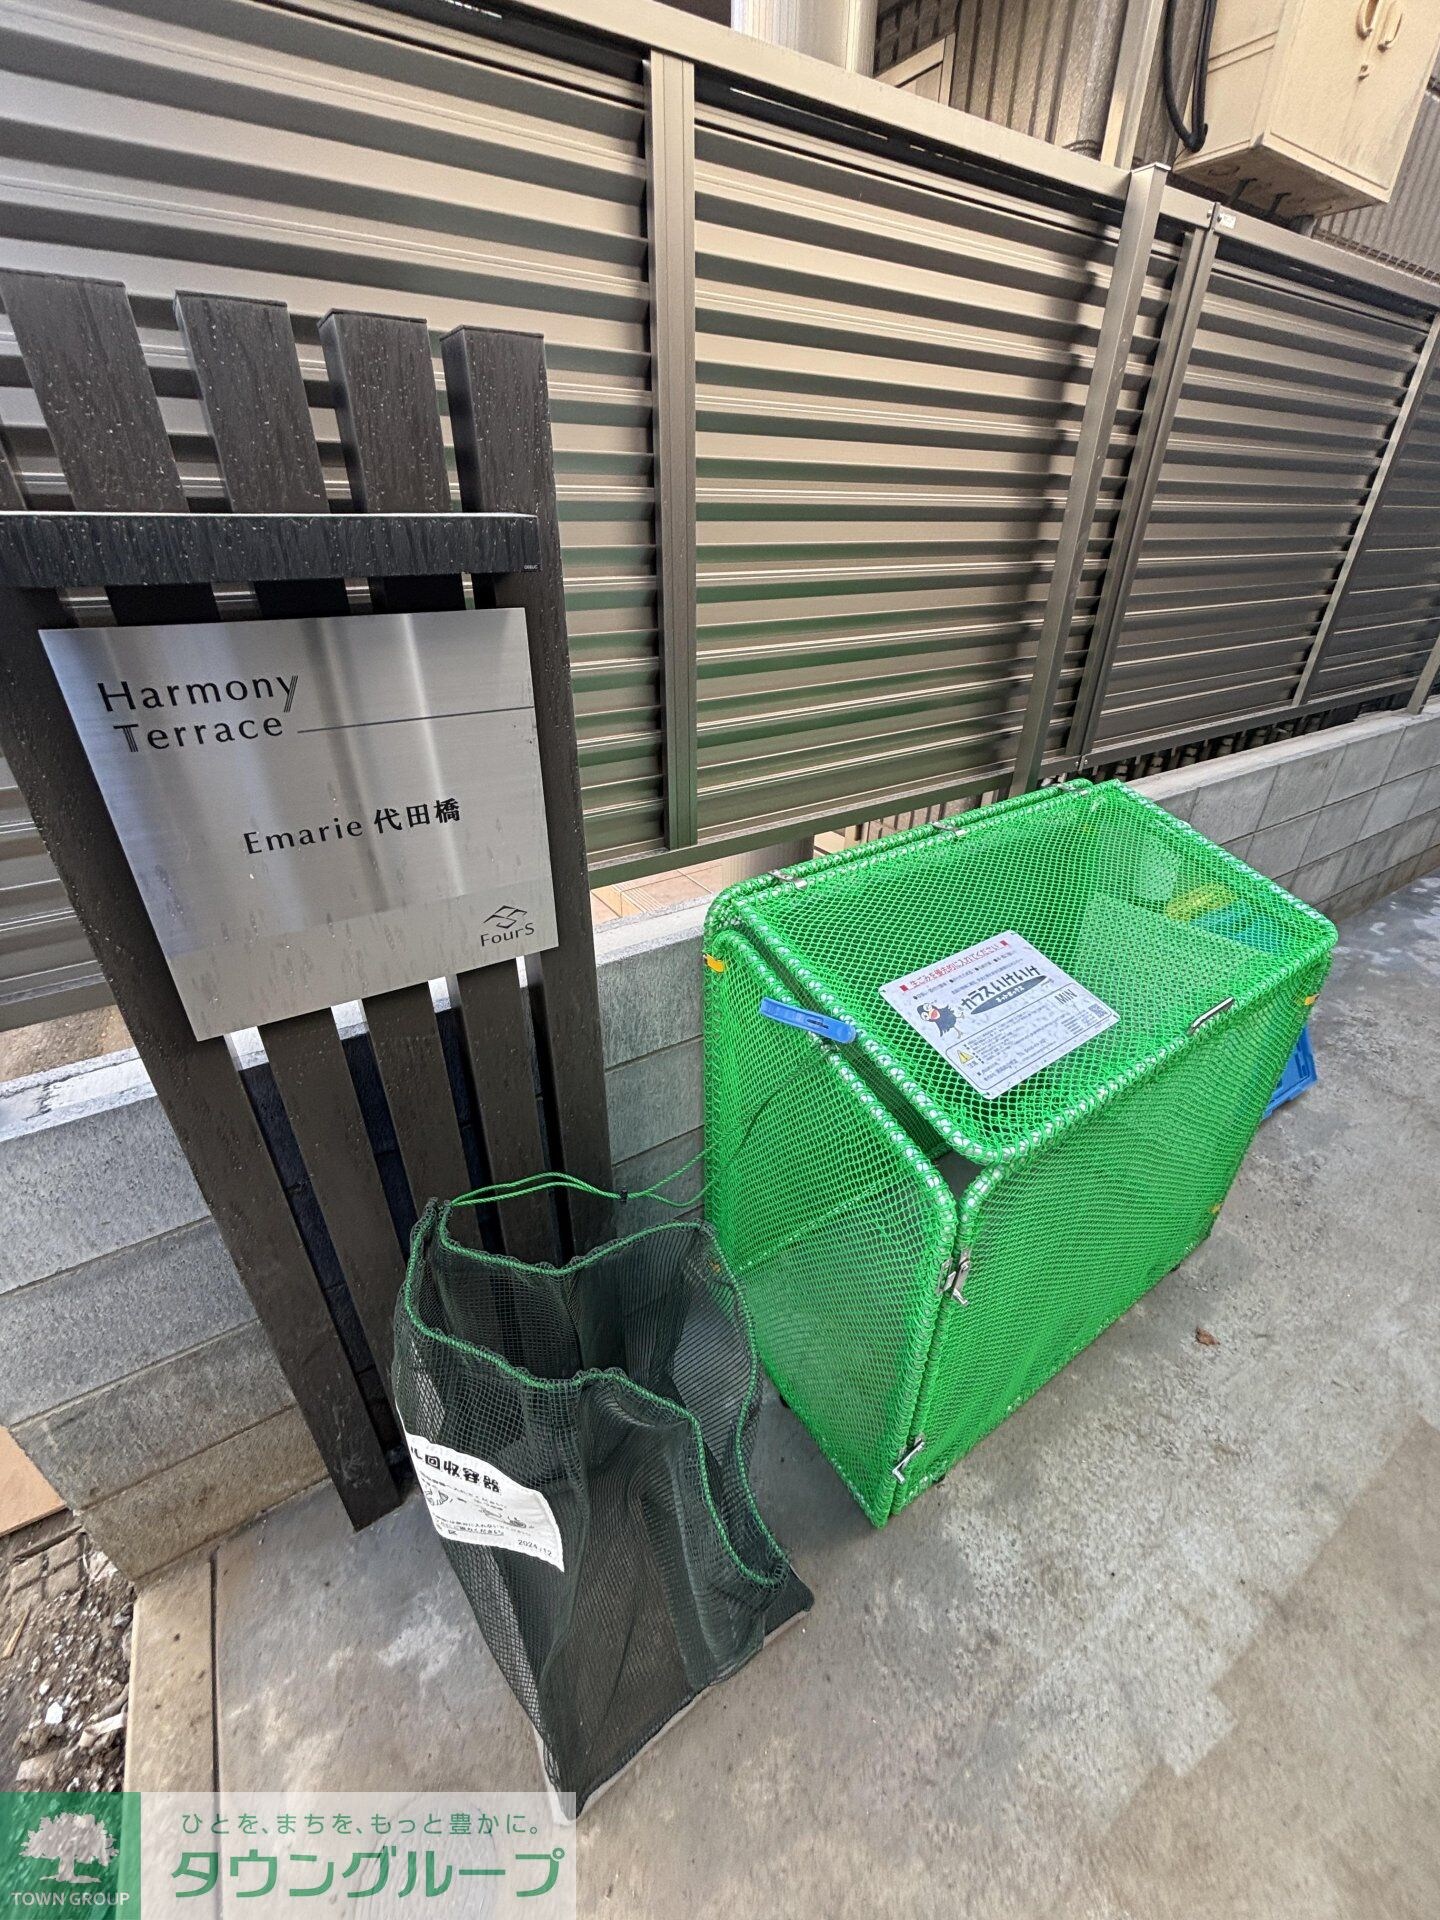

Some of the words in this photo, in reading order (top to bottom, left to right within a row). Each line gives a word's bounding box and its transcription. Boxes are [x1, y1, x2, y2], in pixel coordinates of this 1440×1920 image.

[97, 675, 299, 713] Harmony
[113, 716, 284, 753] Terrace
[243, 817, 364, 855] Emarie
[373, 797, 462, 834] 代田橋
[479, 922, 536, 947] FourS
[961, 965, 1041, 1011] カラスいけいけ
